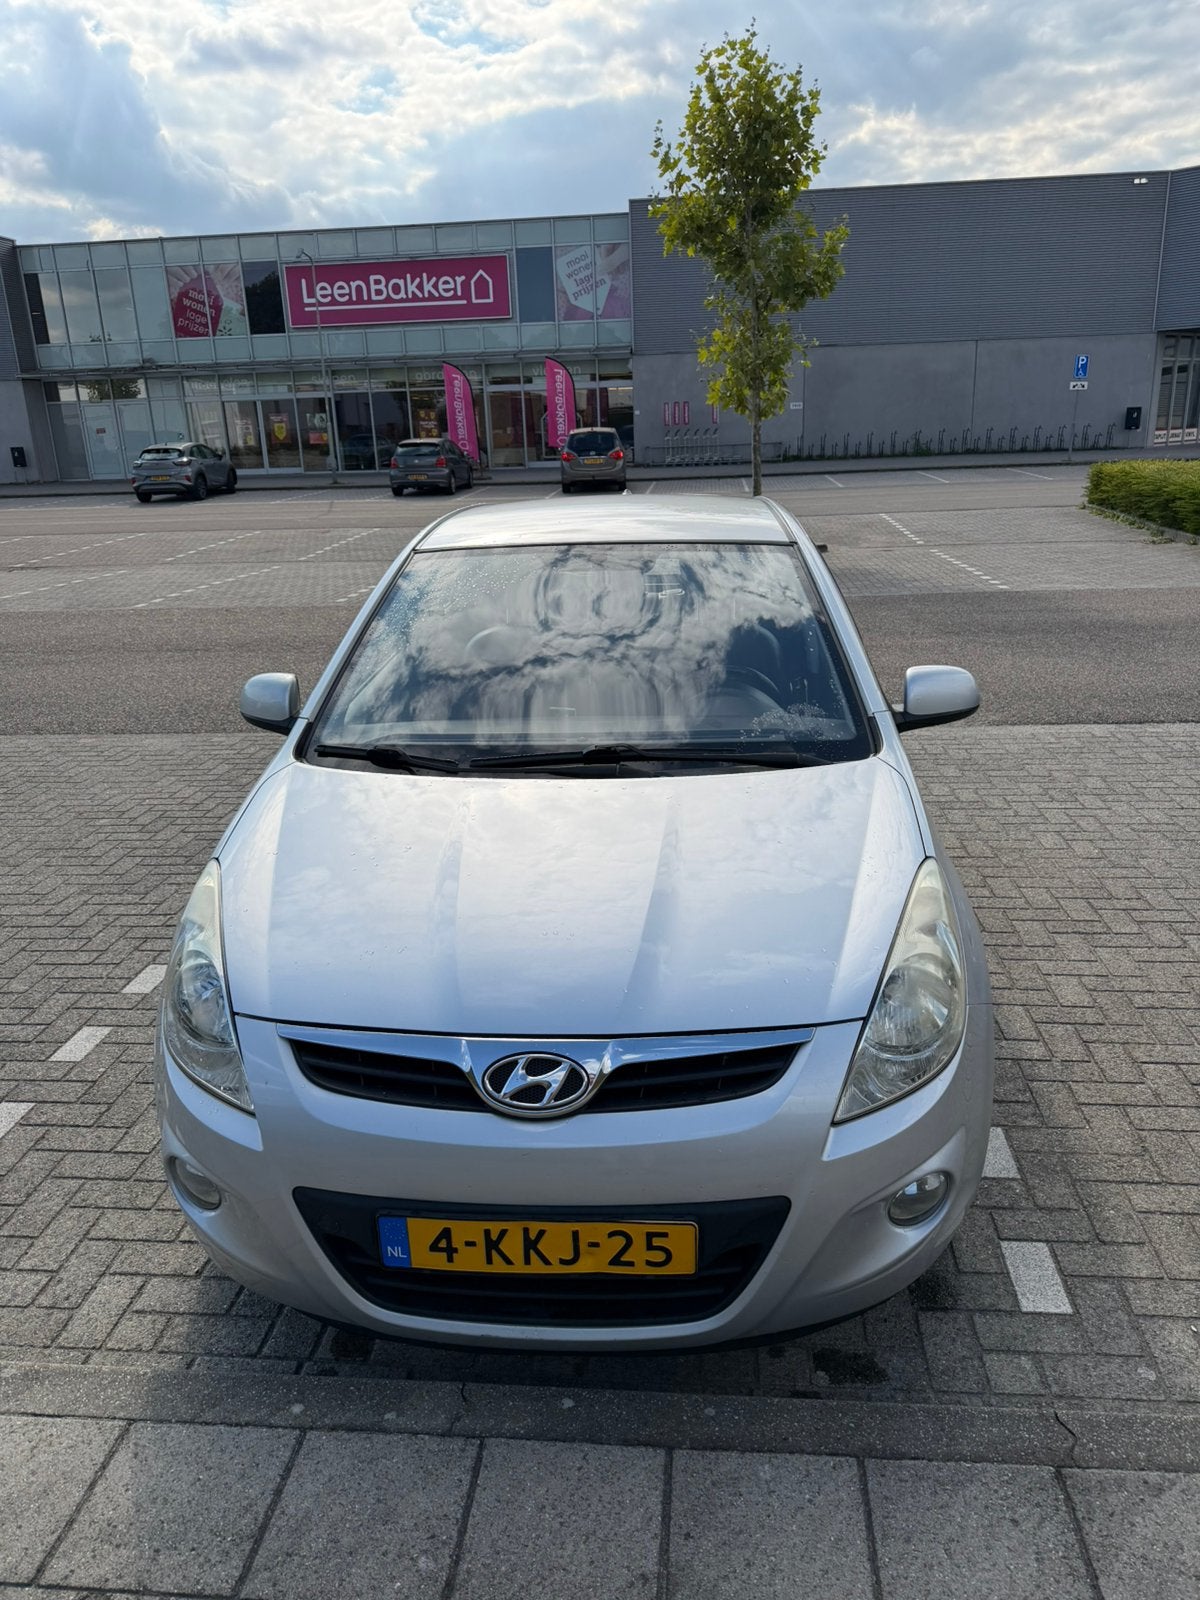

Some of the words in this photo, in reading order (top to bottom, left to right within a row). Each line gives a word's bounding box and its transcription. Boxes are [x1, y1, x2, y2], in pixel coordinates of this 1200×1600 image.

[188, 290, 215, 306] moi
[1078, 356, 1087, 369] P
[386, 1246, 407, 1259] NL
[428, 1226, 674, 1268] 4-KKJ-25
